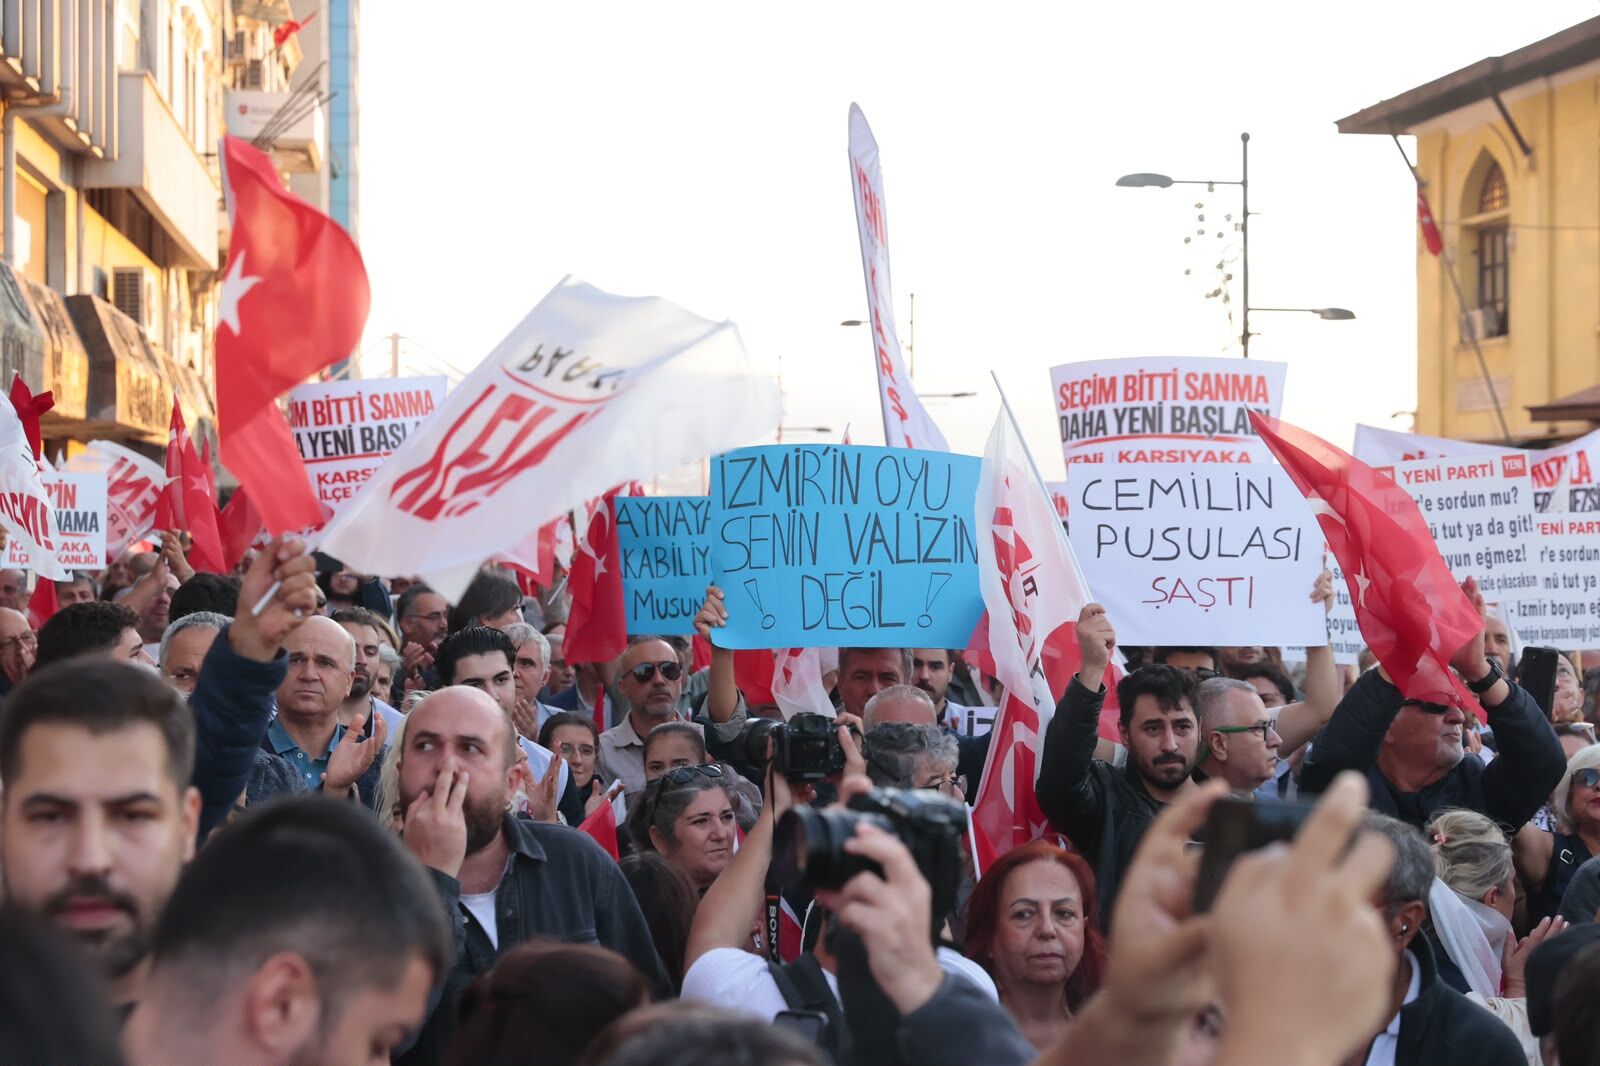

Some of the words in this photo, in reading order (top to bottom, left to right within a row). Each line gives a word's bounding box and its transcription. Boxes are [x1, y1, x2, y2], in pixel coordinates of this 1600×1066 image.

[312, 391, 365, 426] BİTTİ
[369, 389, 435, 421] SANMA
[1059, 374, 1117, 412] SEÇİM
[1123, 368, 1178, 402] BİTTİ
[1185, 371, 1270, 404] SANMA
[307, 424, 355, 458] YENİ
[1060, 409, 1108, 443] DAHA
[1113, 402, 1164, 436] YENİ
[719, 447, 861, 510] İZMİR'İN
[875, 455, 950, 511] OYU
[1402, 464, 1441, 484] YENİ
[1447, 460, 1494, 480] PARTİ
[319, 487, 352, 501] İLÇE
[1082, 472, 1273, 511] CEMİLİN
[1437, 491, 1486, 511] sordun
[1491, 486, 1519, 506] mu?
[720, 508, 819, 573] SENİN
[844, 511, 978, 566] VALİZİN
[1096, 524, 1302, 562] PUSULASI
[1442, 521, 1463, 539] tut
[1467, 522, 1483, 542] ya
[1488, 517, 1505, 536] da
[1509, 514, 1533, 538] git!
[1537, 520, 1563, 535] ENİ
[619, 541, 711, 579] KABİLİY
[1476, 544, 1527, 569] eğmez!
[801, 570, 905, 630] DEĞİL
[1142, 576, 1254, 613] ŞAŞTI
[1563, 573, 1580, 588] tut
[1583, 575, 1597, 592] ya
[1551, 600, 1586, 619] boyun
